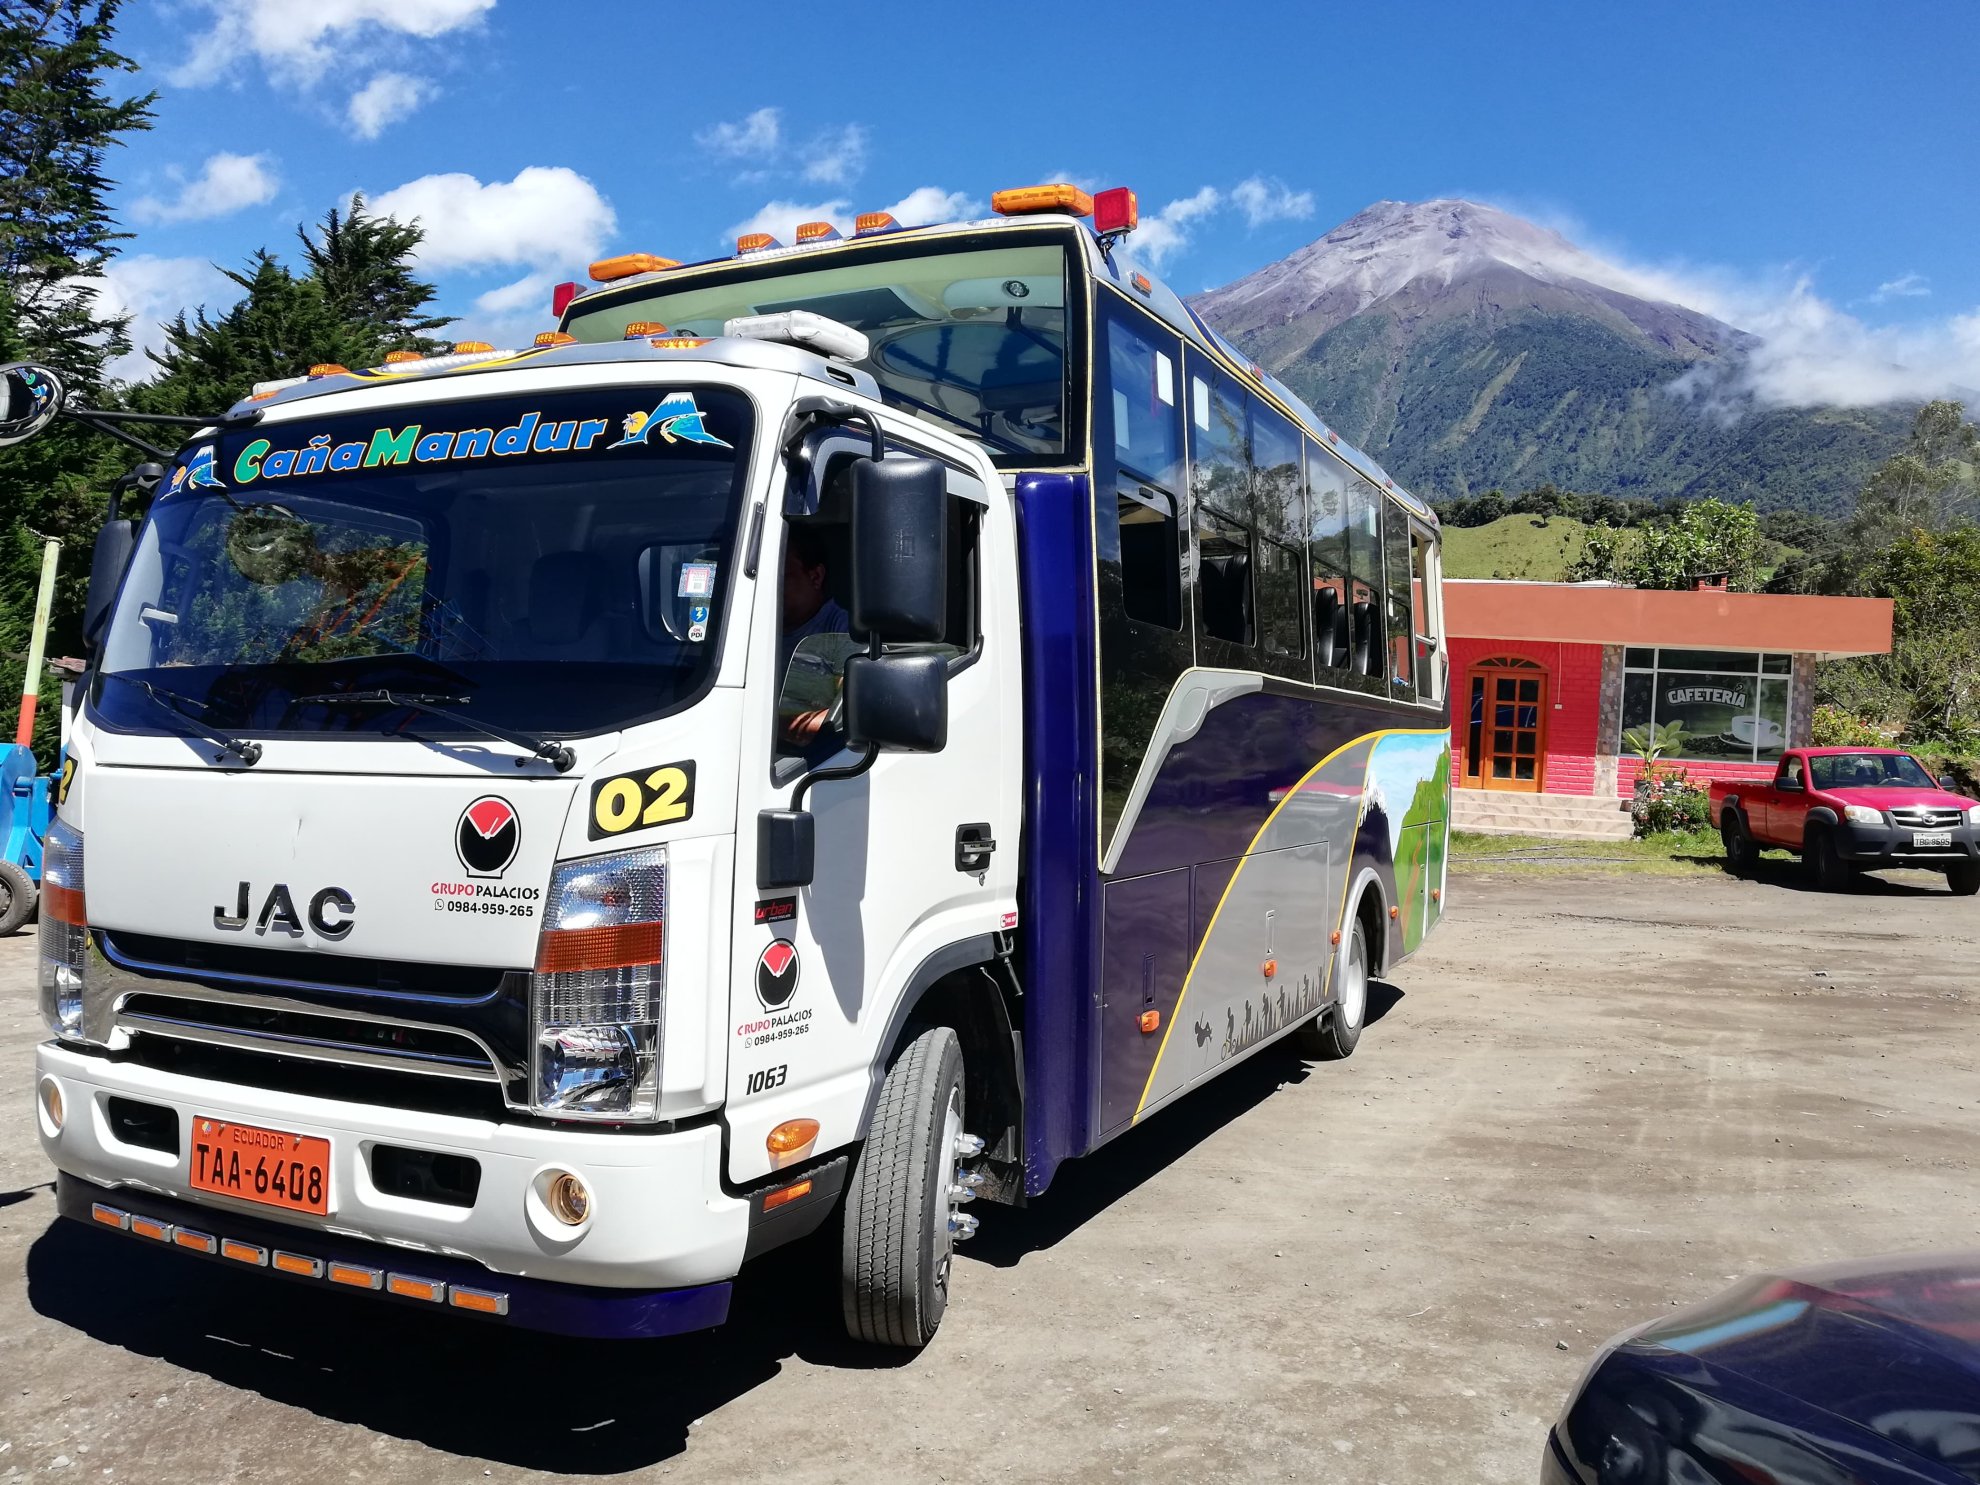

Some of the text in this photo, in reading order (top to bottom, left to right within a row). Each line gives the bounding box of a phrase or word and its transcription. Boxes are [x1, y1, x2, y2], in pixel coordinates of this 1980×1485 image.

[595, 767, 688, 832] 02
[431, 882, 540, 900] GRUPO PALACIOS
[213, 881, 356, 942] JAC
[447, 900, 534, 917] 0984-959-265
[771, 1008, 812, 1028] PALACIOS
[754, 1023, 810, 1046] 0984-959-265
[746, 1063, 788, 1096] 1063
[233, 1128, 284, 1151] ECUADOR
[196, 1143, 322, 1205] TAA-6408
